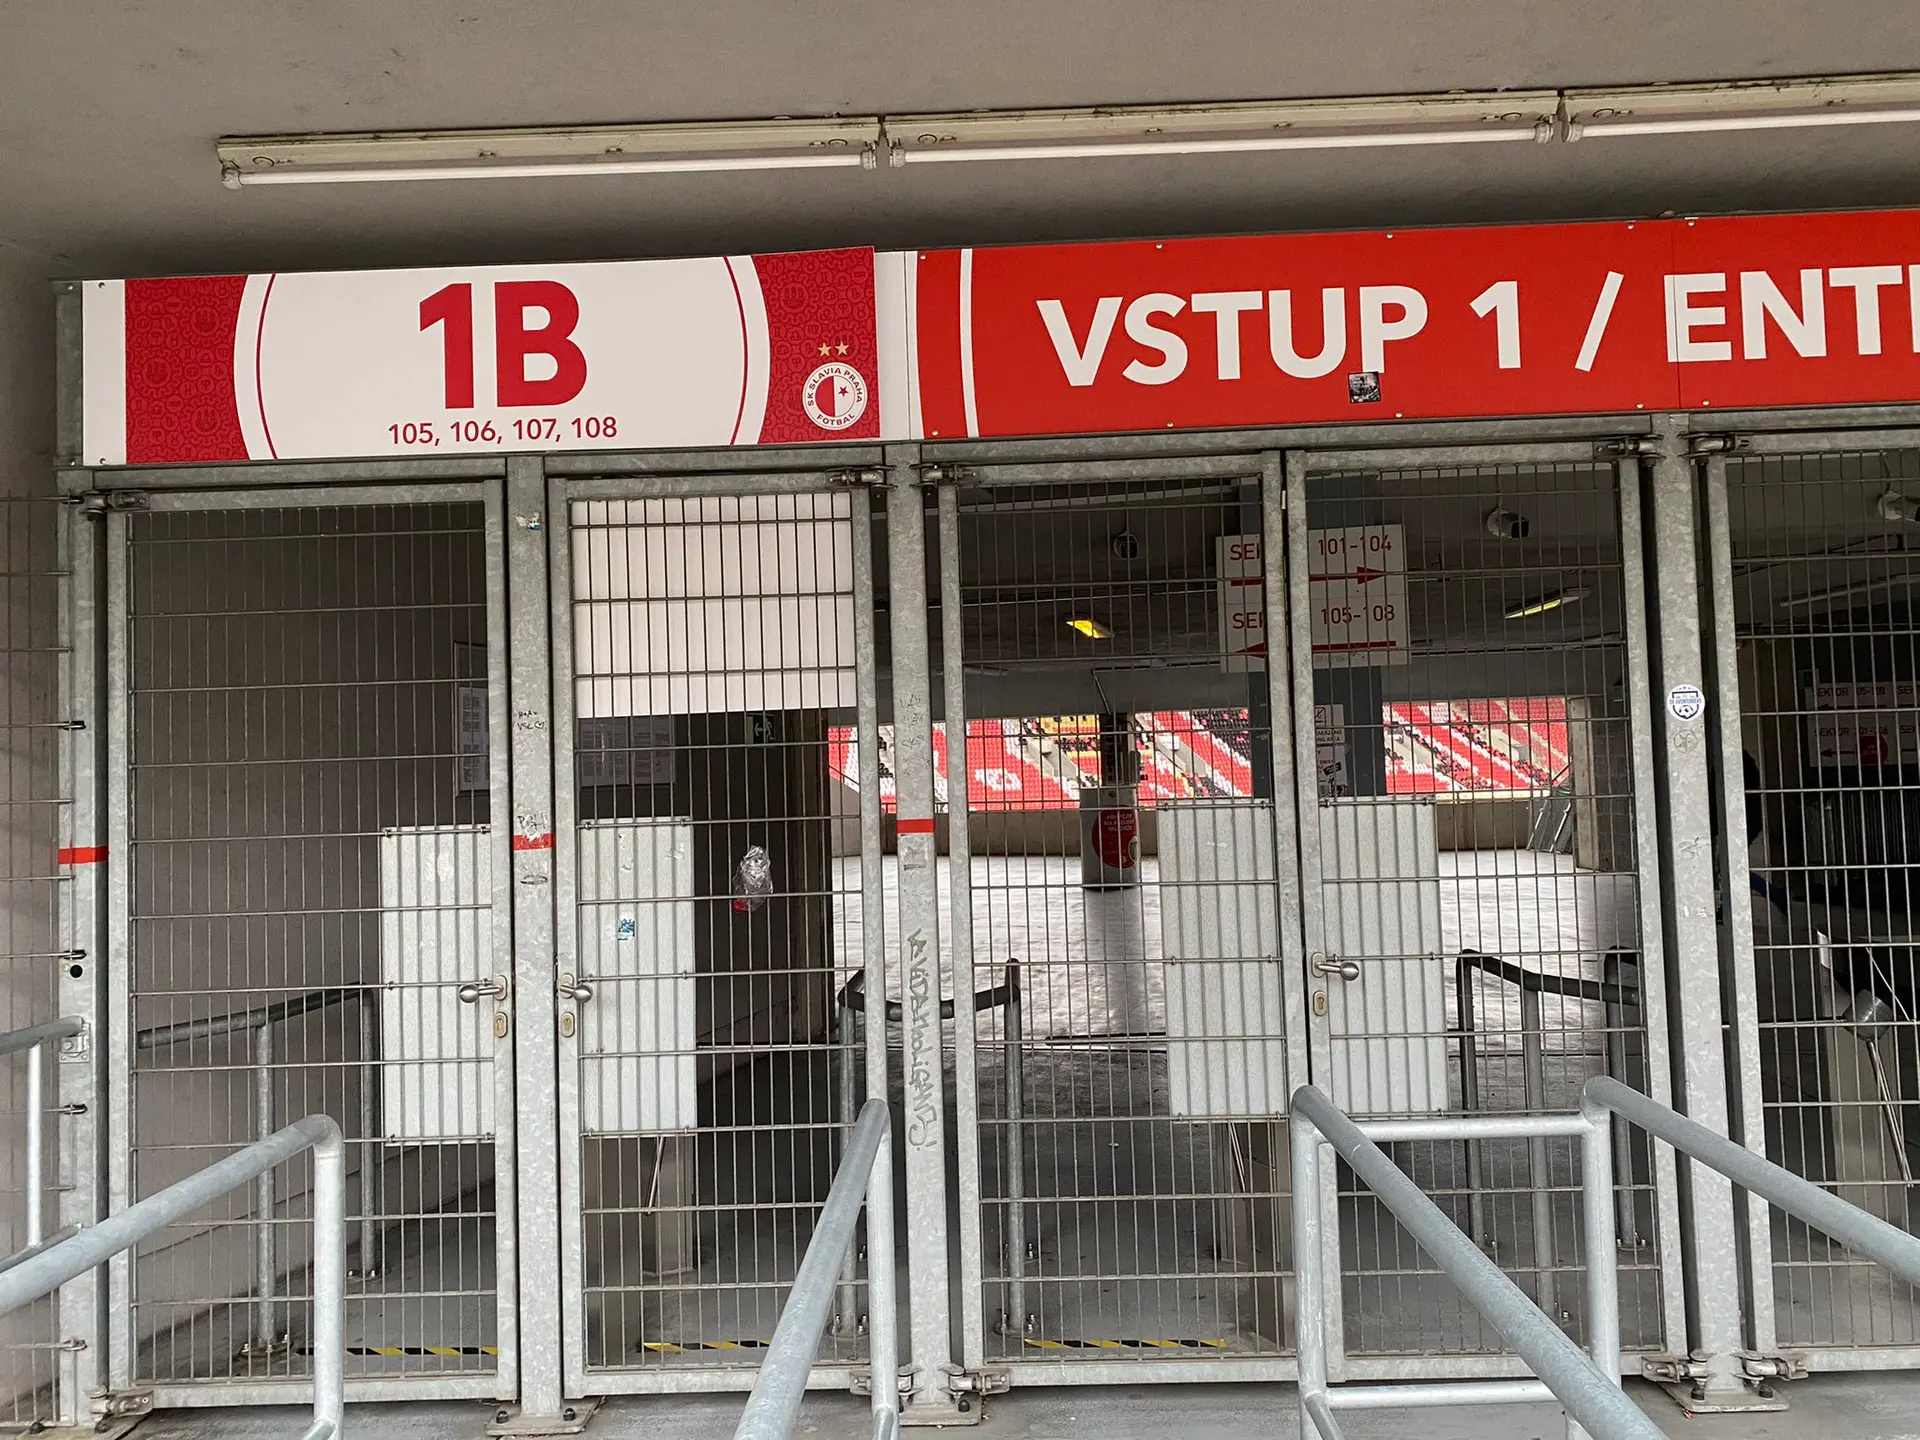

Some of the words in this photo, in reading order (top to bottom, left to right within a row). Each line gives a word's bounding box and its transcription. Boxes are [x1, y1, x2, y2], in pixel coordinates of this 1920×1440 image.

[1036, 285, 1429, 387] VSTUP
[1469, 281, 1521, 368] 1
[1575, 271, 1624, 372] /
[1662, 264, 1920, 363] ENT
[420, 280, 587, 409] 1B
[808, 367, 842, 390] SLAVIA
[843, 369, 863, 403] PRAHA
[806, 392, 815, 407] SK
[388, 422, 440, 446] 105,
[450, 420, 502, 444] 106,
[513, 418, 561, 442] 107,
[571, 416, 617, 438] 108
[816, 413, 856, 426] FOTBAL
[1812, 687, 1849, 697] EKTOR
